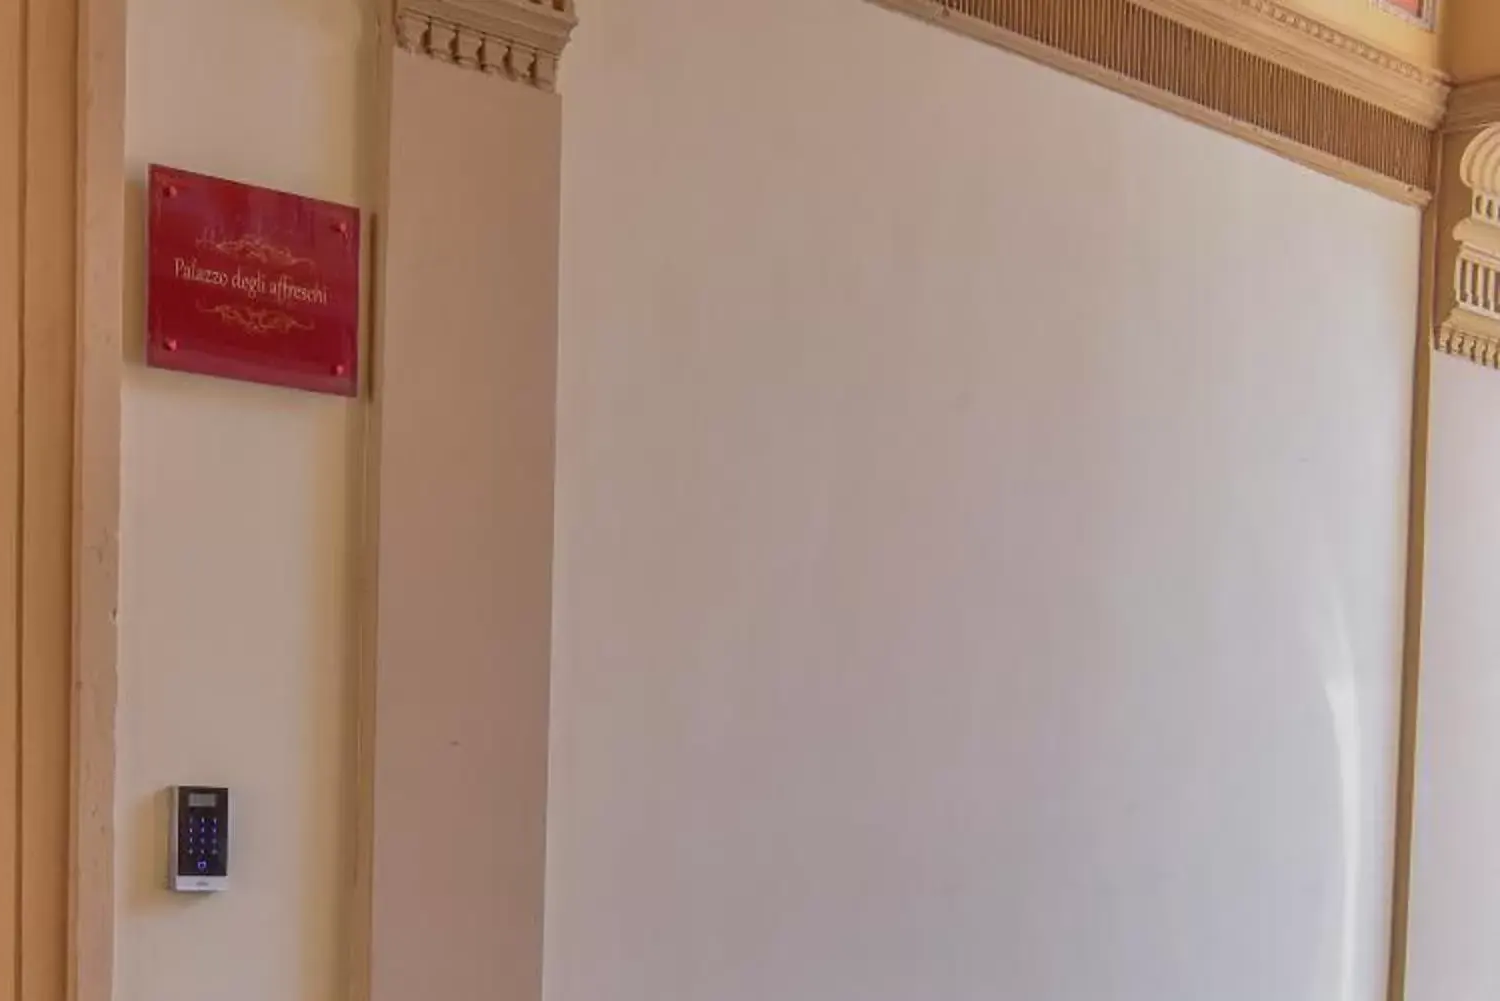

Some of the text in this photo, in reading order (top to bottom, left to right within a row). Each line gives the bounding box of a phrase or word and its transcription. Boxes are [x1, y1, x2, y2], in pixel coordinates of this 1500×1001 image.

[174, 257, 328, 305] Palazzo degli affreschi
